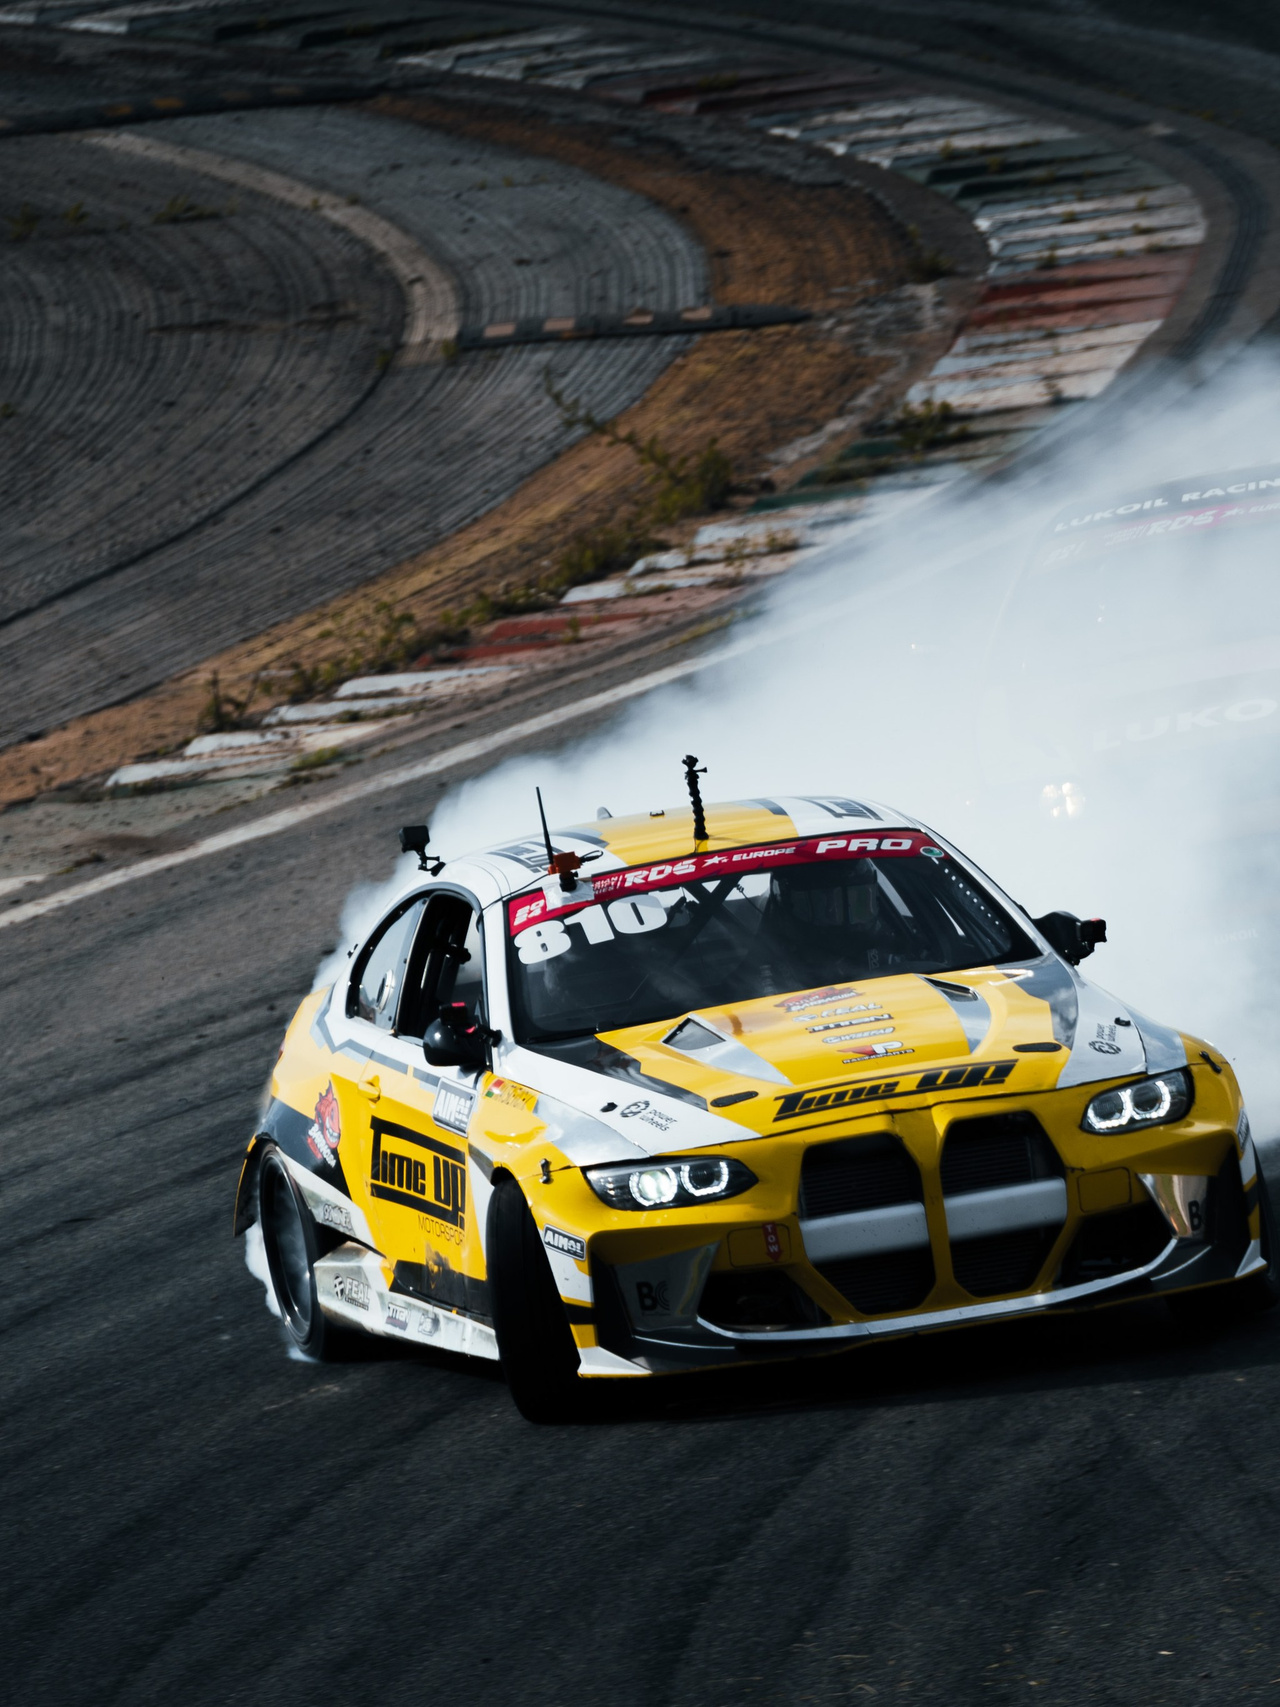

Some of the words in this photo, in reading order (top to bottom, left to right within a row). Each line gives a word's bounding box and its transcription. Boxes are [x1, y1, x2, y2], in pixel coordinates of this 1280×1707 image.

[1055, 498, 1168, 532] LUKOIL
[1147, 510, 1218, 536] RDS
[624, 858, 697, 887] RDS
[732, 847, 796, 862] EUROPE
[816, 838, 913, 854] PRO
[513, 894, 668, 964] 810
[418, 1214, 465, 1246] MOTORSPOR
[764, 1224, 779, 1252] TOW
[345, 1276, 371, 1304] FEAL
